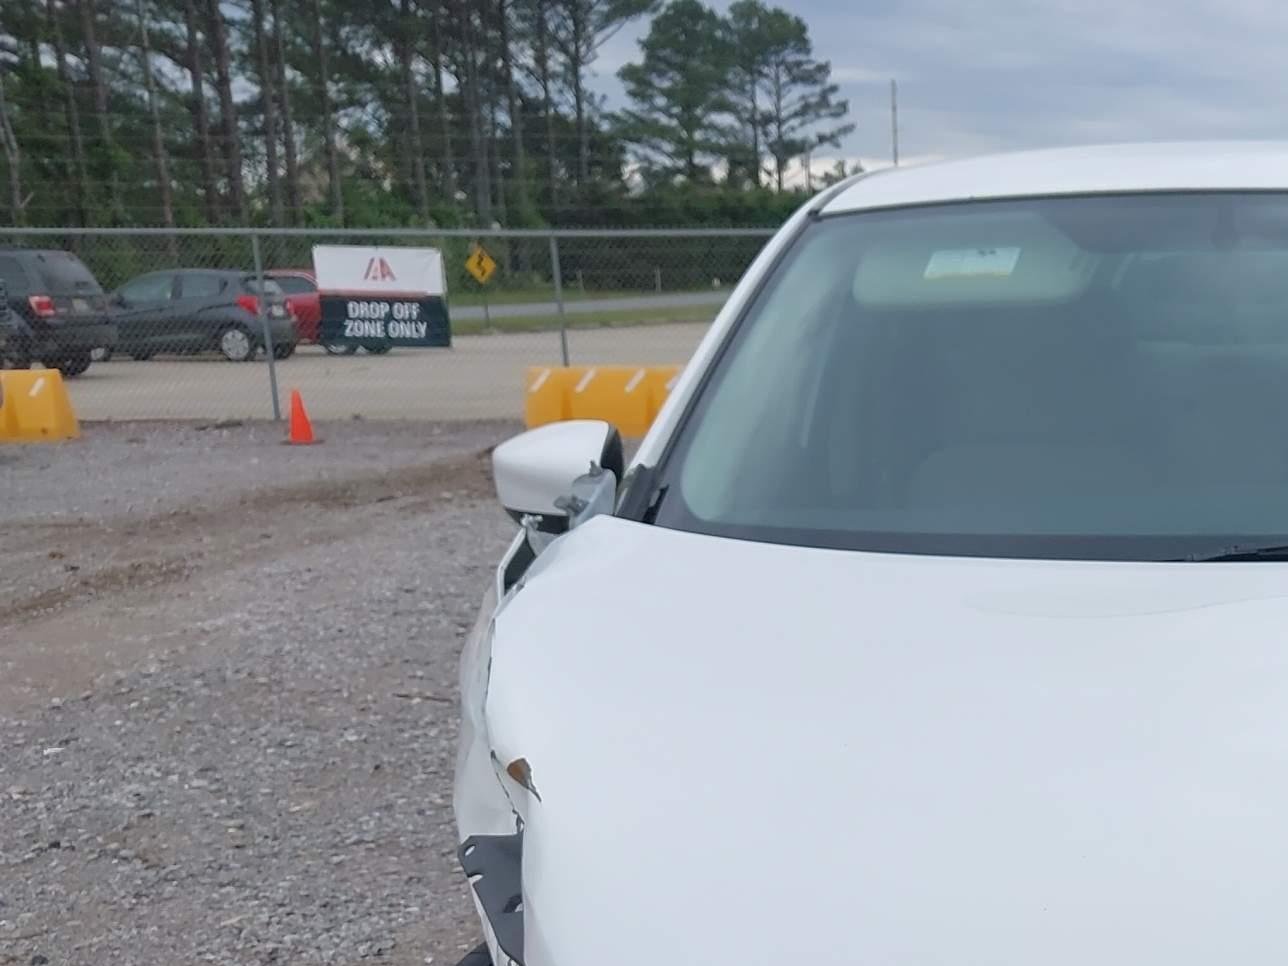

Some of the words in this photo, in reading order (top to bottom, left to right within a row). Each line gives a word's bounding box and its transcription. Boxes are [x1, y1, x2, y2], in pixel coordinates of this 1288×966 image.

[347, 301, 390, 319] DROP
[392, 302, 420, 320] OFF
[344, 320, 386, 337] ZONE
[388, 321, 427, 338] ONLY
